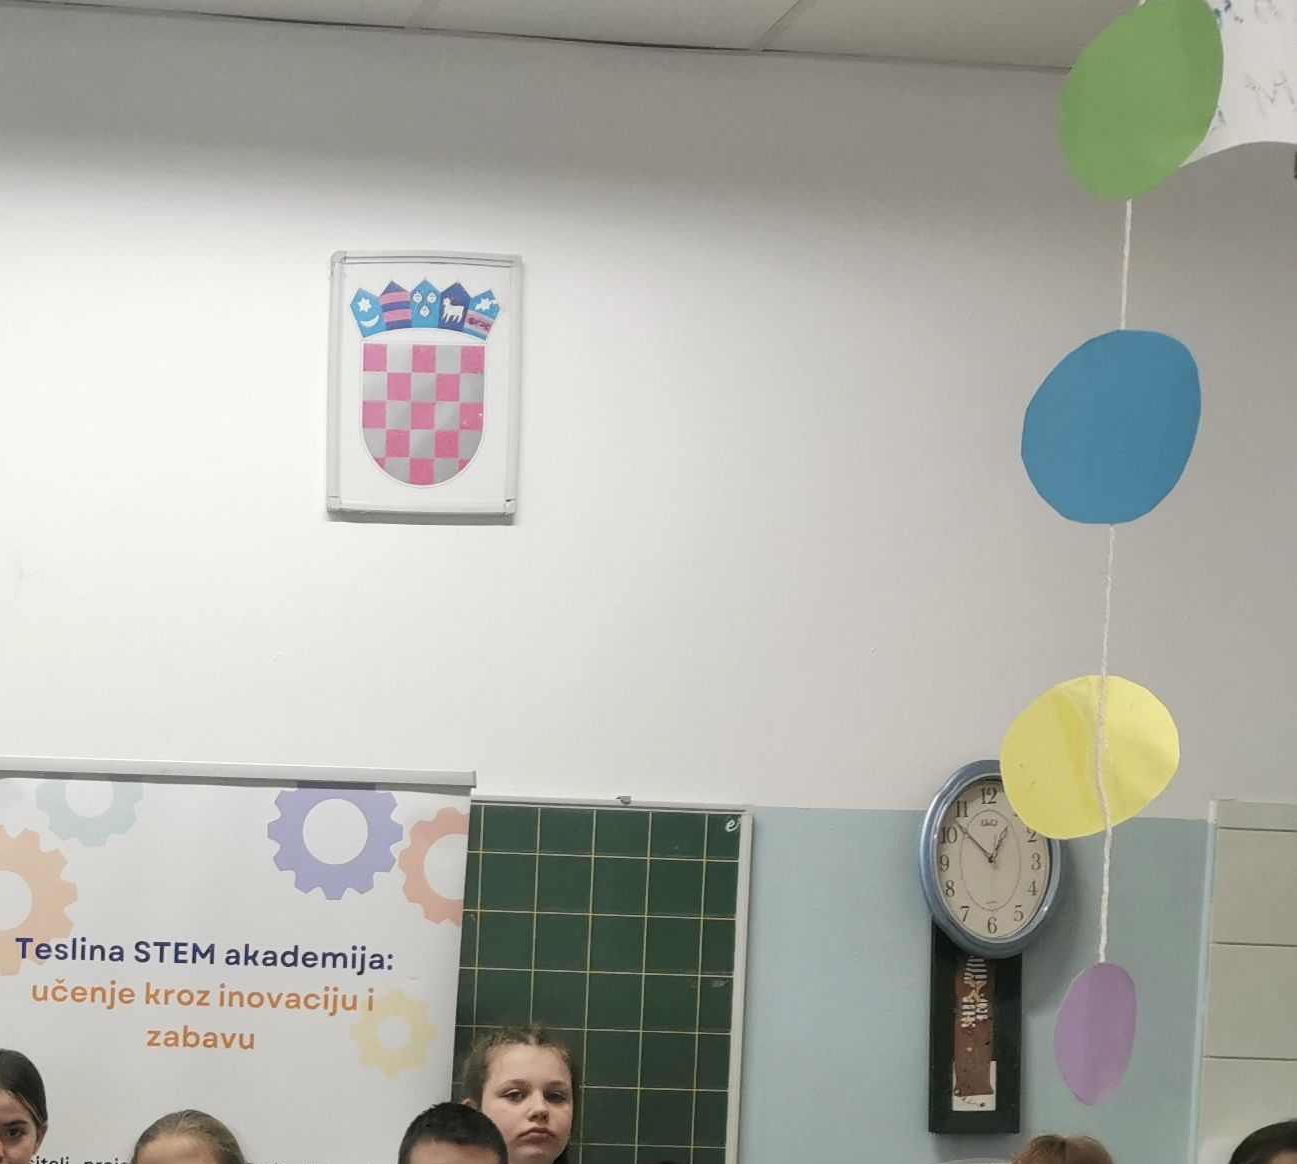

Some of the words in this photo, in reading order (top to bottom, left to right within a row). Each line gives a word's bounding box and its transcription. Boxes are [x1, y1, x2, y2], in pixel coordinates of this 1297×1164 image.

[981, 787, 997, 804] 12
[955, 801, 968, 818] 11
[940, 826, 958, 845] 10
[939, 854, 950, 872] 9
[1031, 852, 1041, 871] 3
[945, 880, 955, 897] 8
[1027, 880, 1038, 896] 4
[961, 906, 970, 922] 7
[1014, 904, 1024, 922] 5
[987, 916, 998, 934] 6
[15, 937, 124, 962] Teslina
[134, 940, 215, 965] STEM
[225, 943, 393, 976] akademija:
[32, 978, 135, 1010] učenje
[145, 982, 210, 1007] kroz
[219, 983, 358, 1017] inovaciju
[367, 987, 374, 1012] i
[146, 1024, 255, 1050] zabavu
